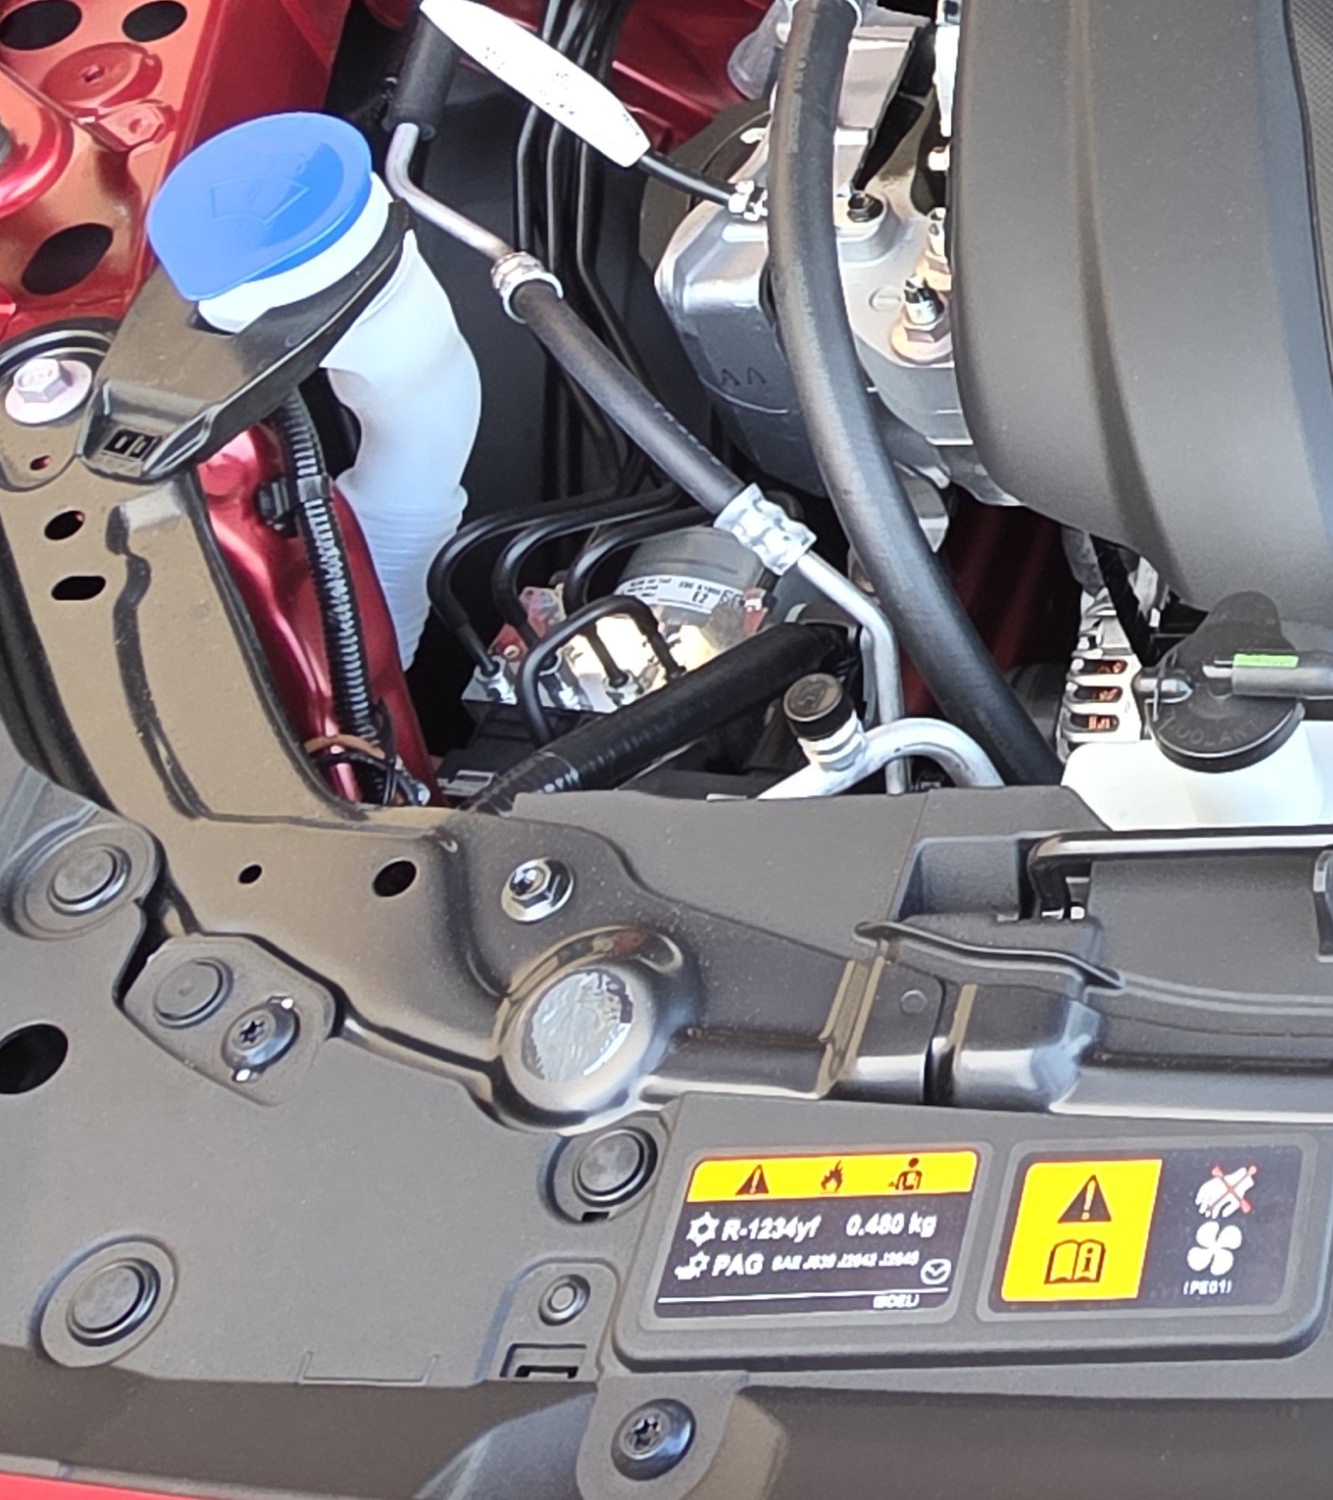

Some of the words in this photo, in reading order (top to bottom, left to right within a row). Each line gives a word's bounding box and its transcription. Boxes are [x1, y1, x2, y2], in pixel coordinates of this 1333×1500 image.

[721, 1214, 822, 1243] R-1234yf
[908, 1210, 938, 1239] kg
[711, 1252, 764, 1277] PAG
